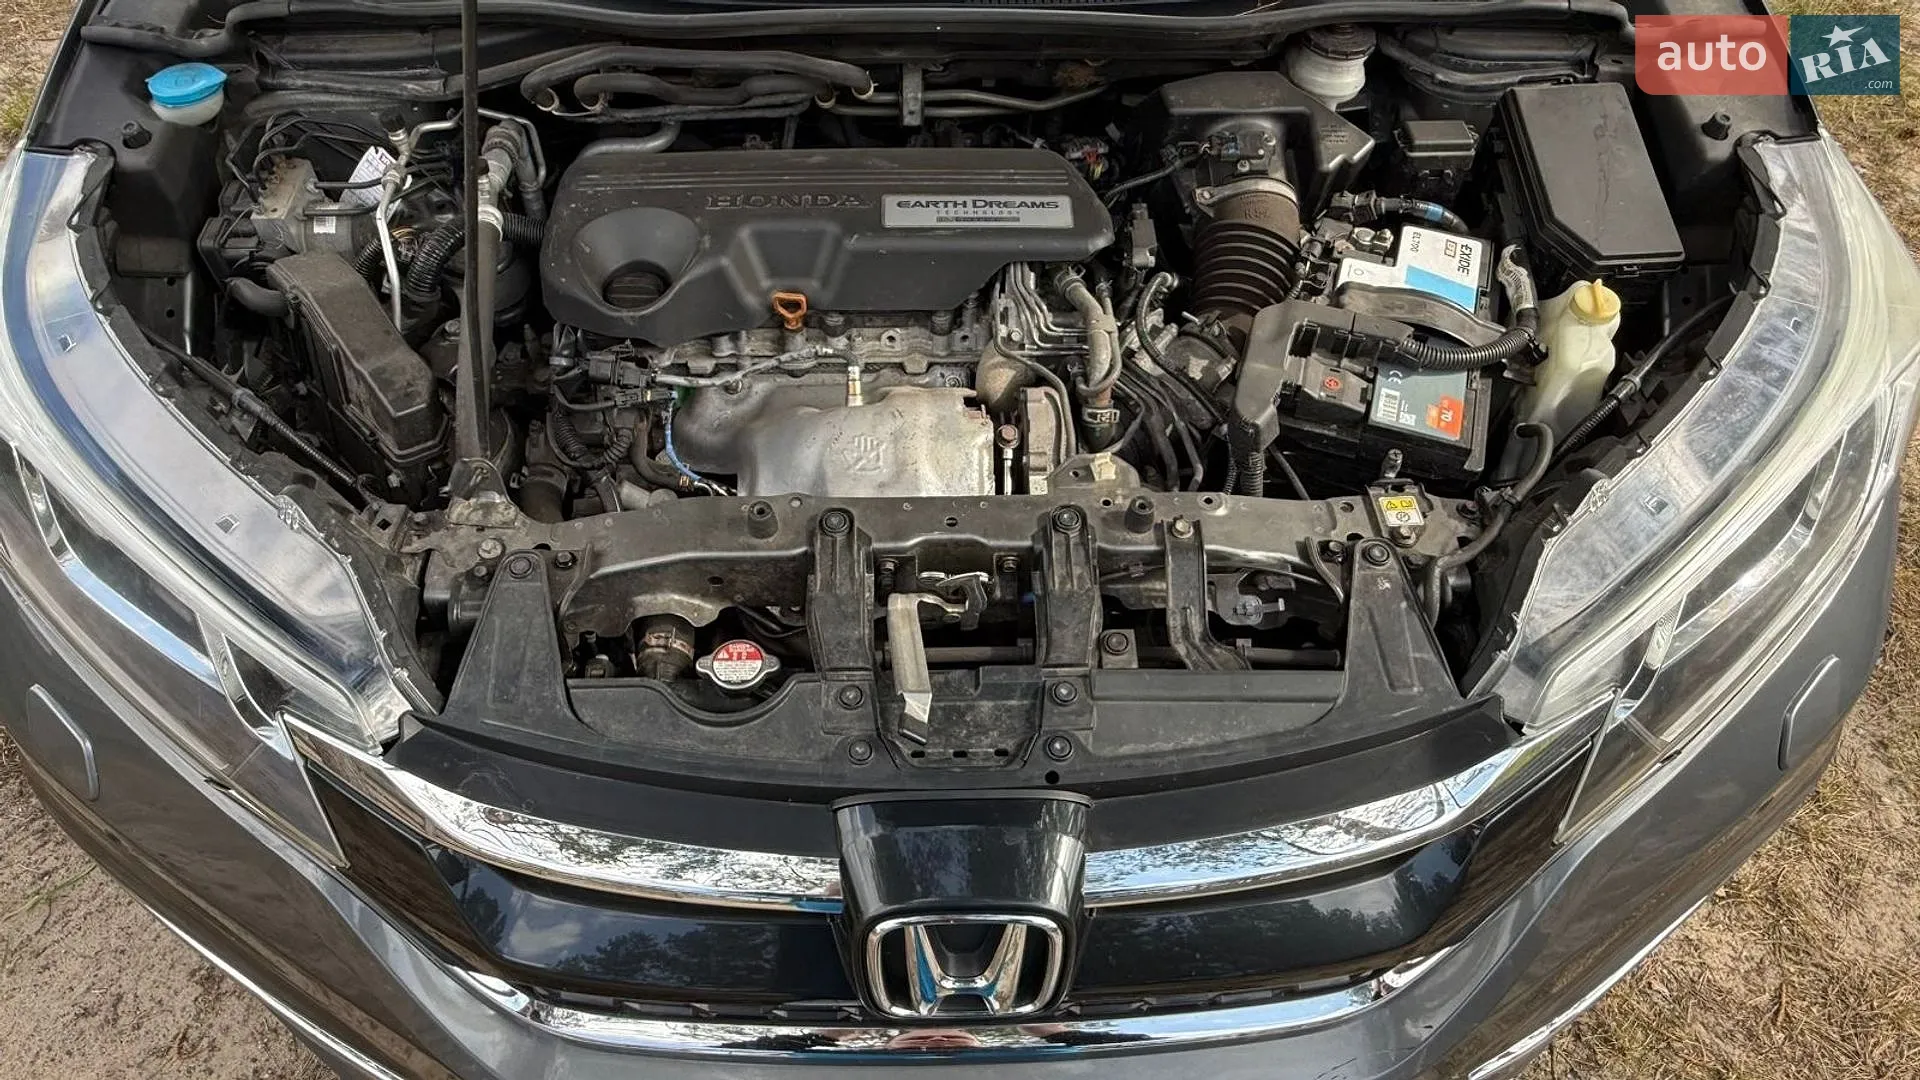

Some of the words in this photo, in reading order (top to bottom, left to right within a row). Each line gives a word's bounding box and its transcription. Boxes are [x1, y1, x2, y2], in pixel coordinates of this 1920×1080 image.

[705, 193, 873, 210] HONDA
[896, 199, 967, 209] EARTH
[971, 199, 1059, 209] DREAMS
[1457, 243, 1473, 276] EXIDE
